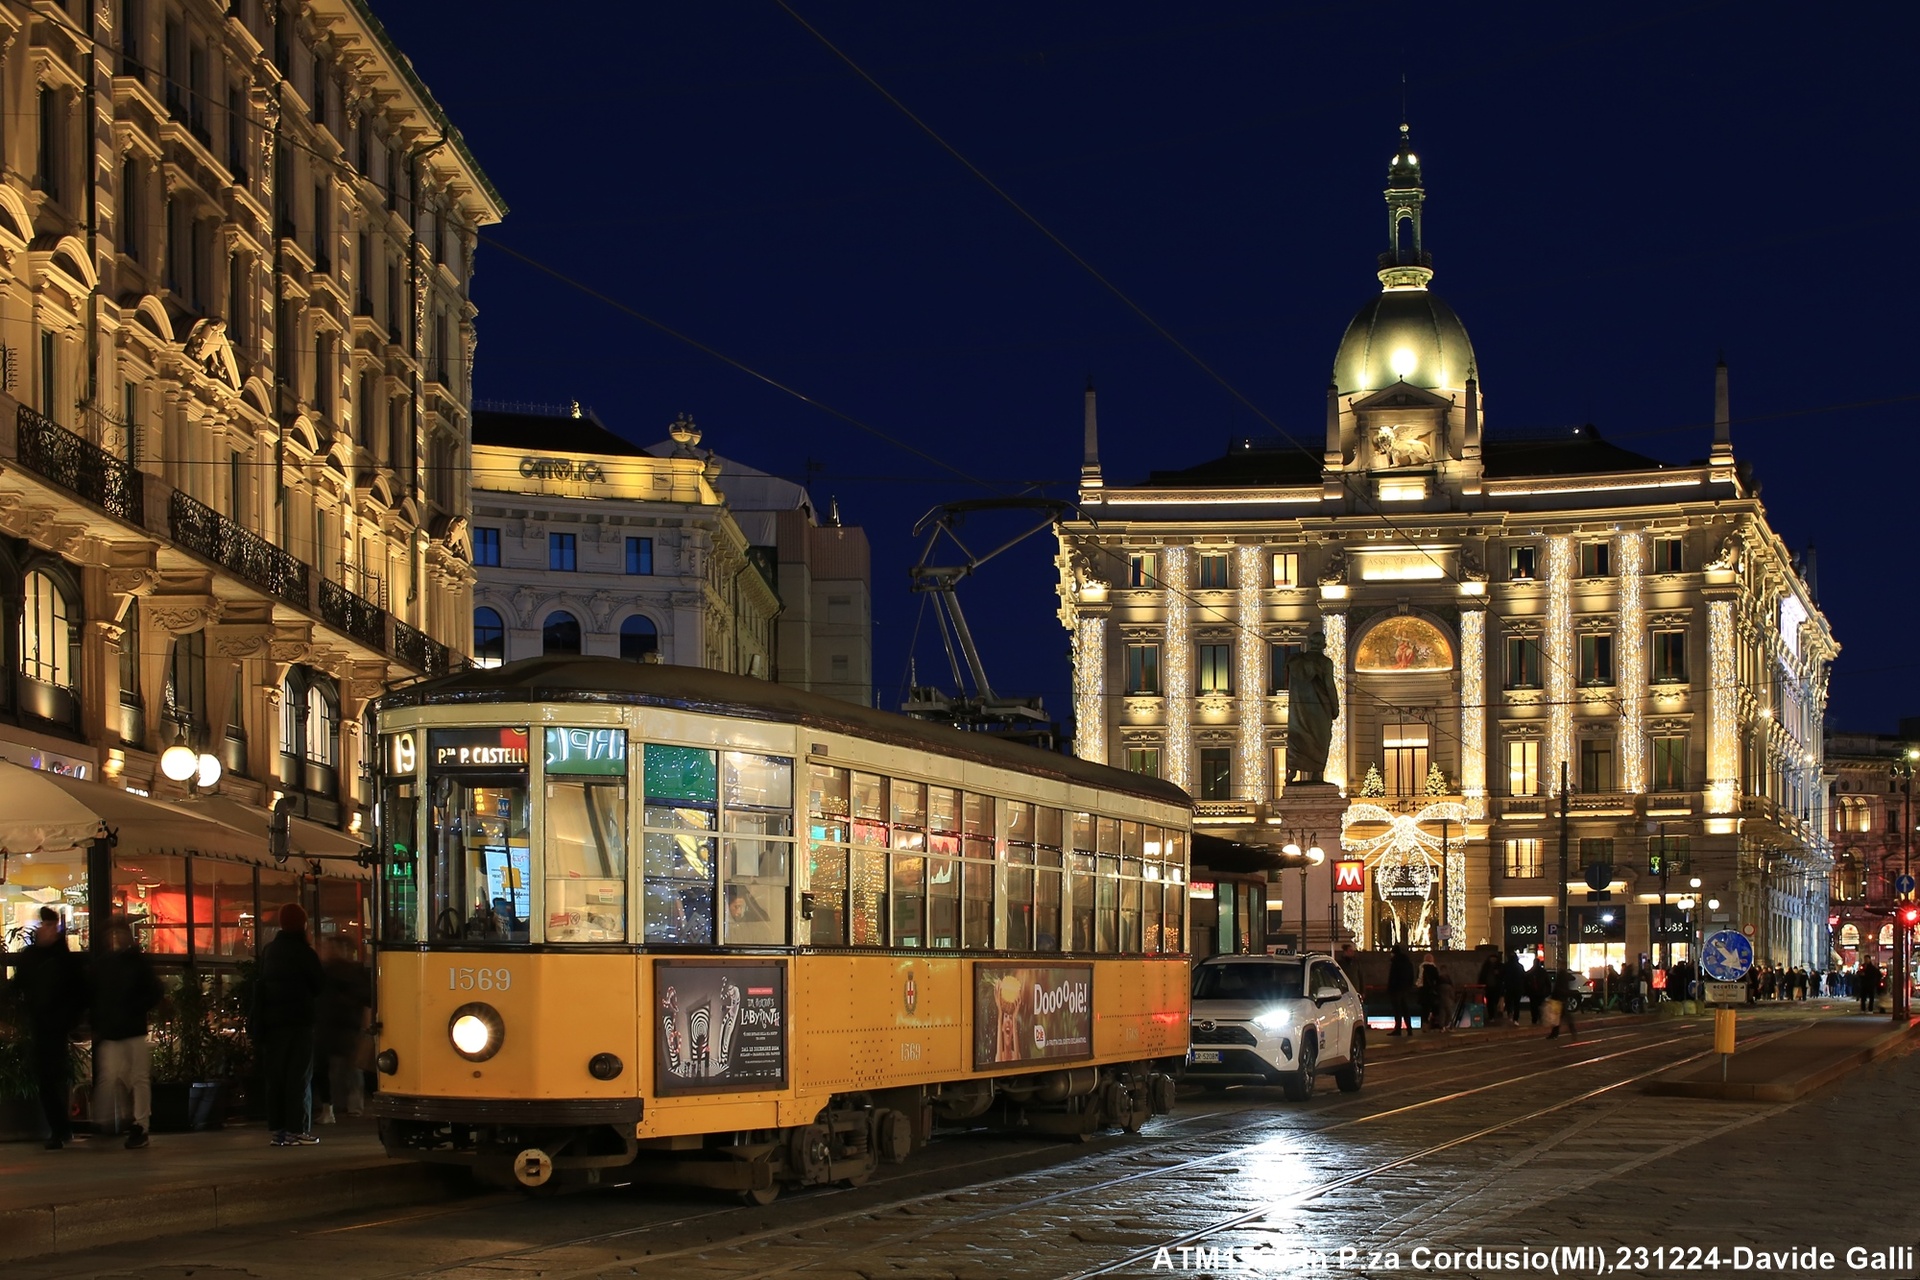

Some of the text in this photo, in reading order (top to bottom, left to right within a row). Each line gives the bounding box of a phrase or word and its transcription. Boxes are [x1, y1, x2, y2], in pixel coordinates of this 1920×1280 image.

[519, 457, 606, 483] CATTOLICA
[394, 733, 416, 774] 19
[1337, 866, 1362, 886] M
[1510, 925, 1538, 935] BOSS
[449, 967, 512, 991] 1569
[741, 1008, 780, 1028] LABYRINTH
[901, 1043, 921, 1061] 1569
